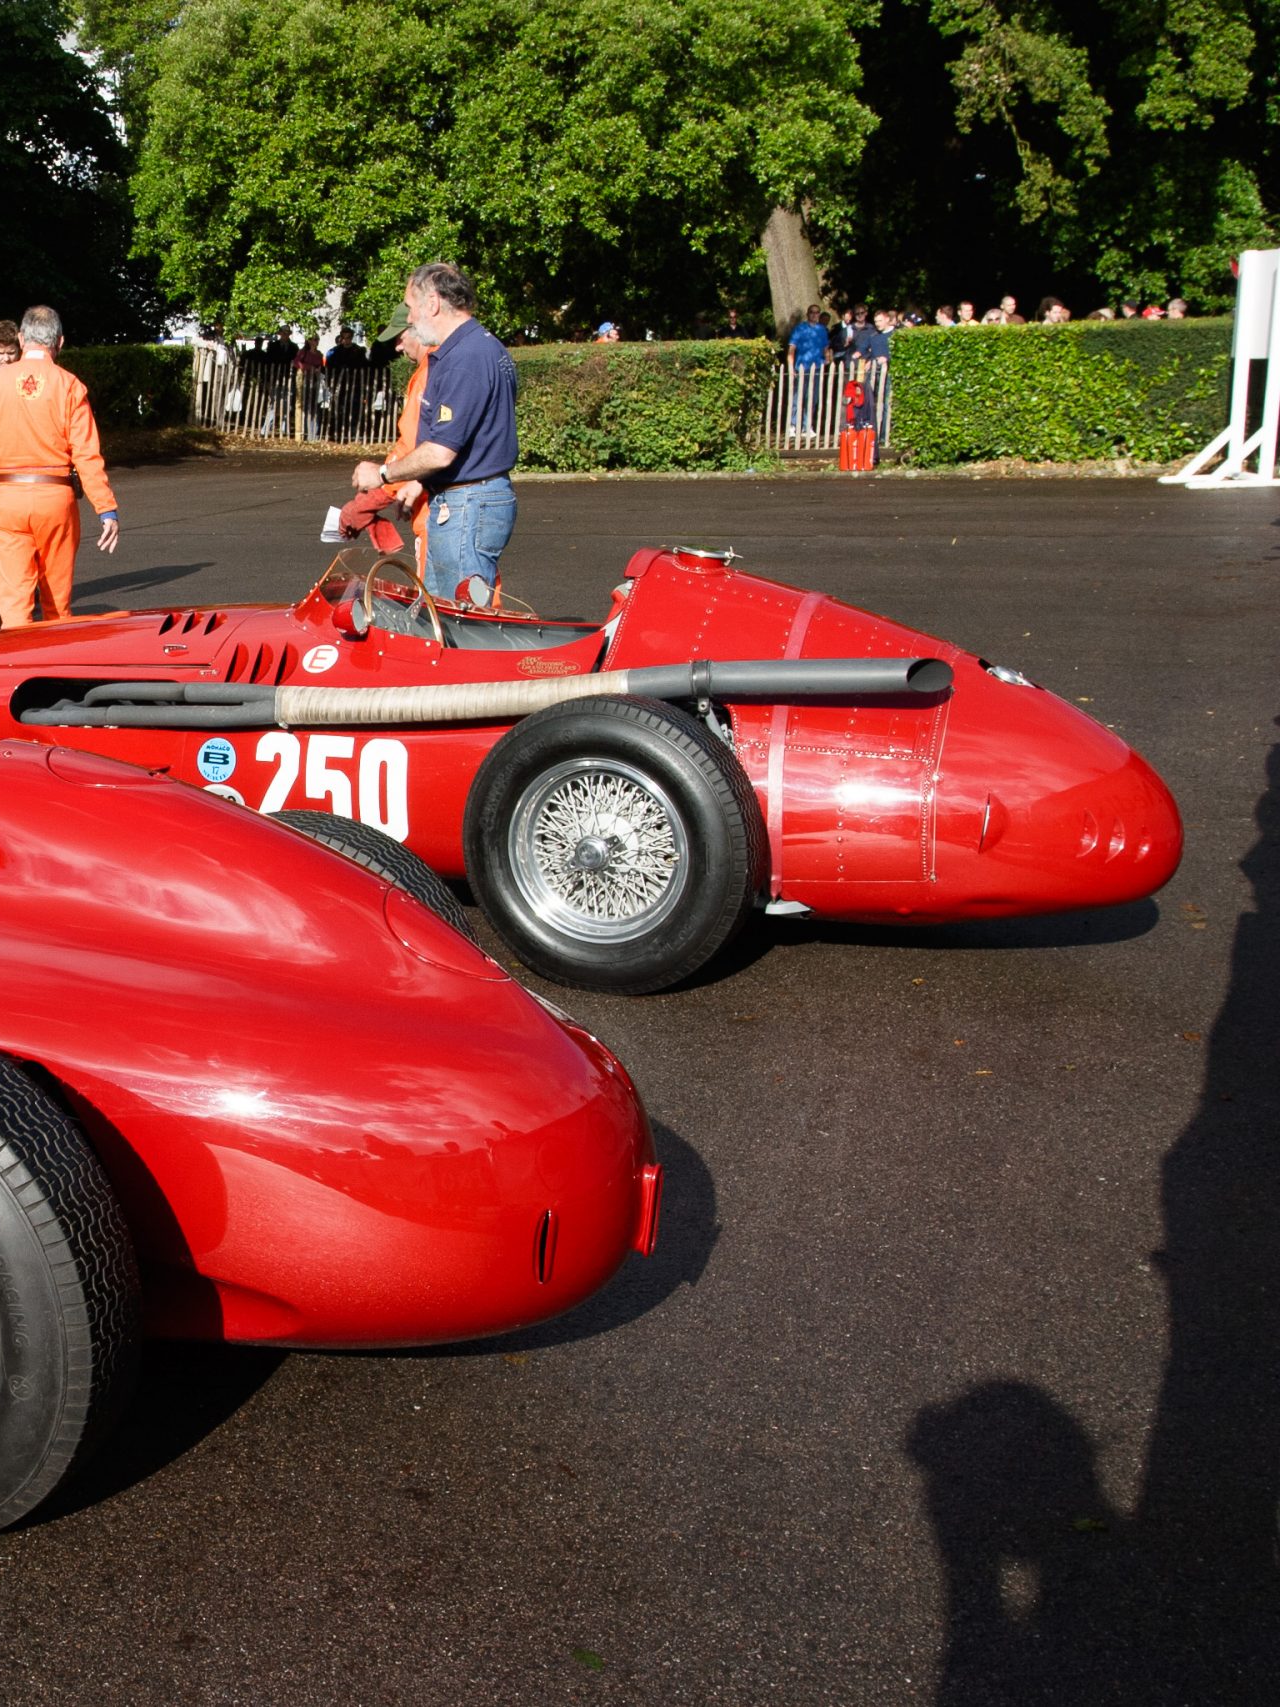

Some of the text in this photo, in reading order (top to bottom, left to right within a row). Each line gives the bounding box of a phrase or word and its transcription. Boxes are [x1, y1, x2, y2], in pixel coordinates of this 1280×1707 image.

[308, 648, 333, 669] E
[206, 744, 231, 752] MONACO
[203, 751, 230, 766] B
[255, 731, 409, 844] 250
